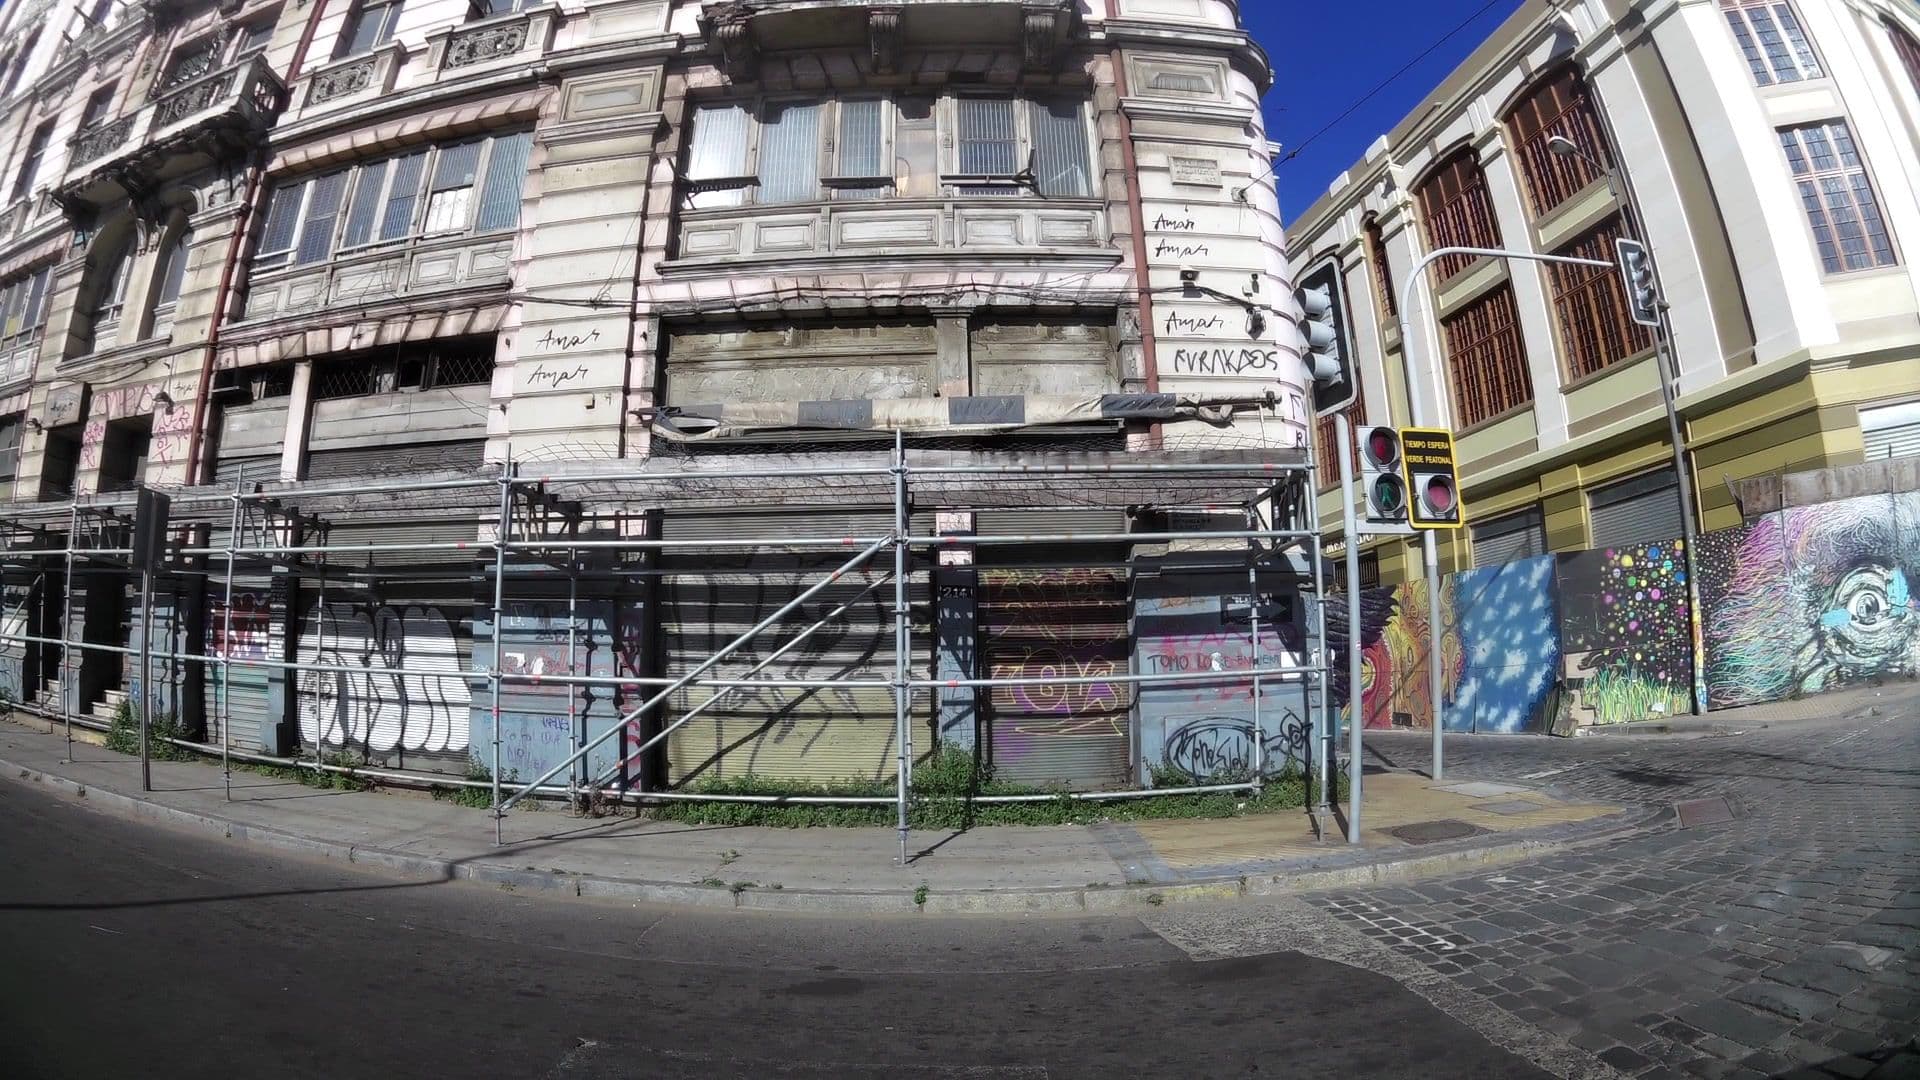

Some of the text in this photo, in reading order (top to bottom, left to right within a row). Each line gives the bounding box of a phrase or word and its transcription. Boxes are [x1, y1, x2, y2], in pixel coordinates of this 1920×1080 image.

[1405, 440, 1449, 450] TIEMPO ESPERA
[1406, 455, 1452, 465] VERDE PEATONAL
